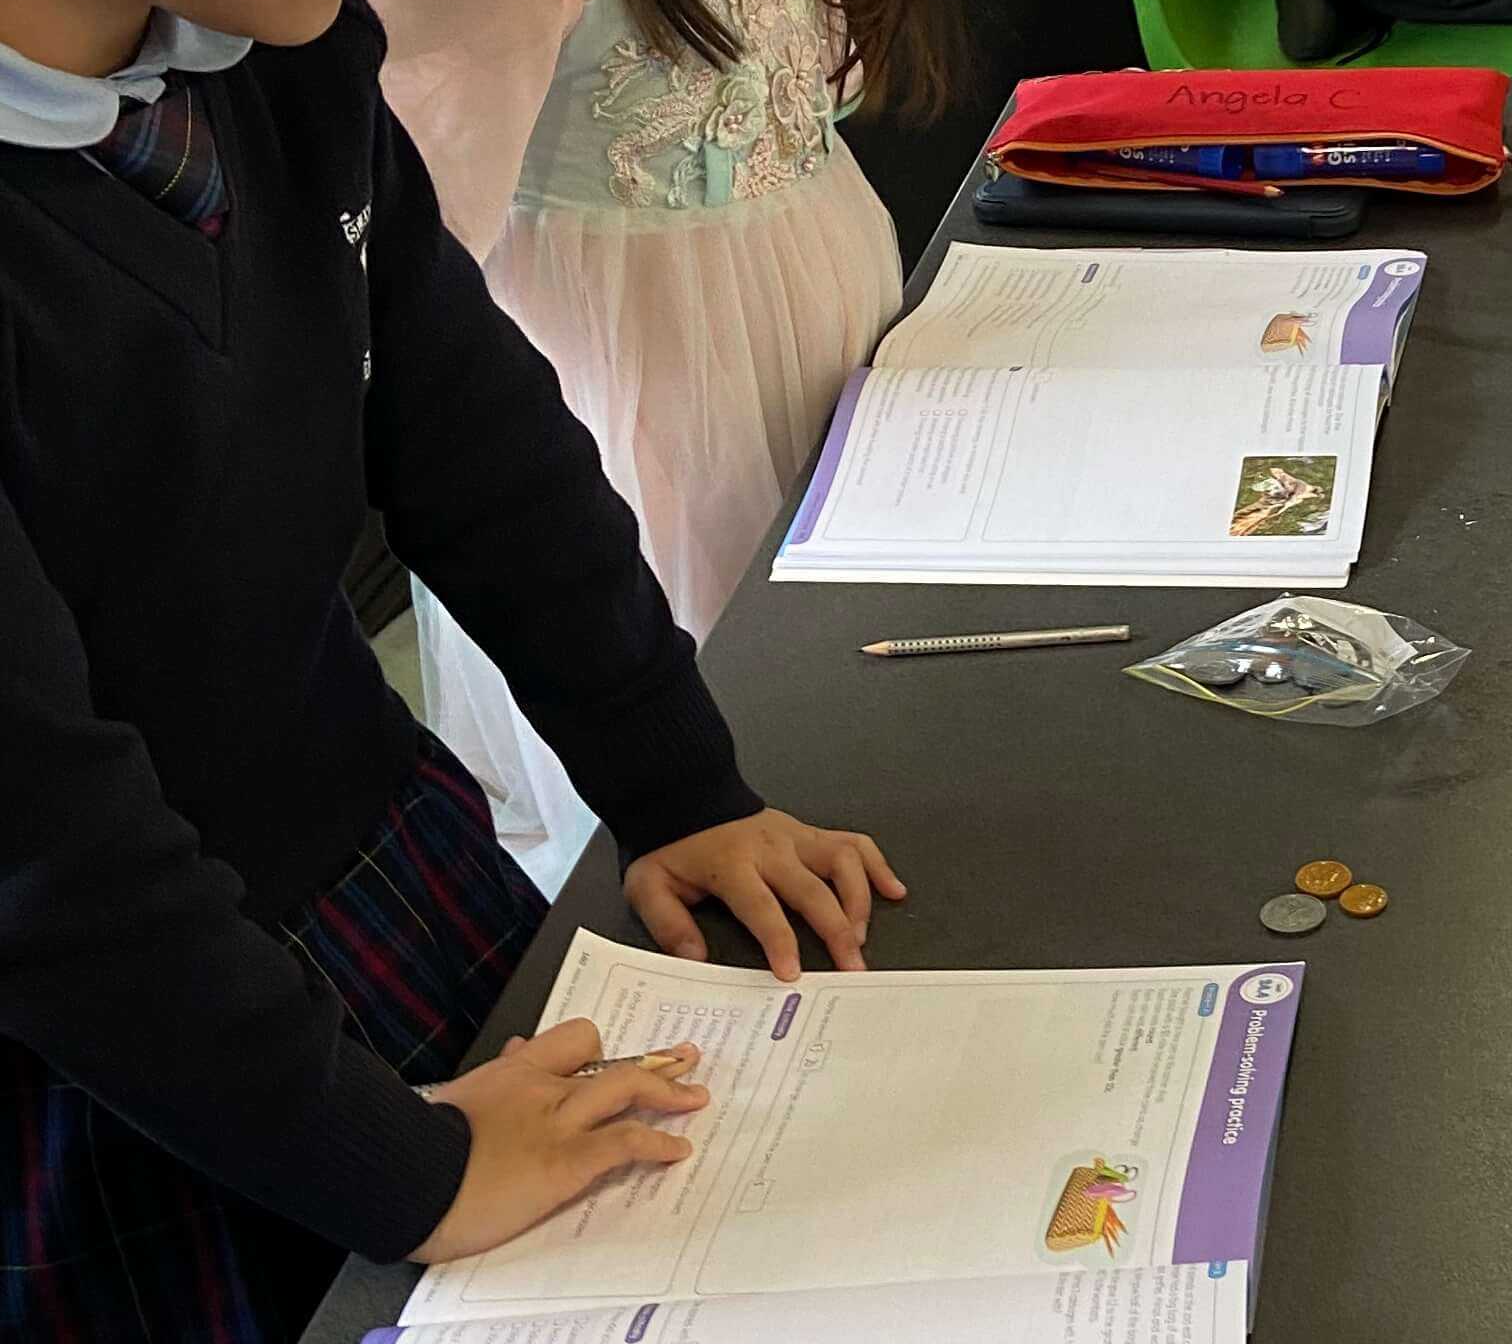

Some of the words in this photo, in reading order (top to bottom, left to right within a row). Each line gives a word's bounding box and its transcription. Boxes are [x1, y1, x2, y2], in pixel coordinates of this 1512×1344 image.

[1166, 84, 1308, 114] Angela
[1329, 88, 1369, 111] C
[1229, 1009, 1268, 1095] Problem-solving
[1222, 1098, 1245, 1145] practice
